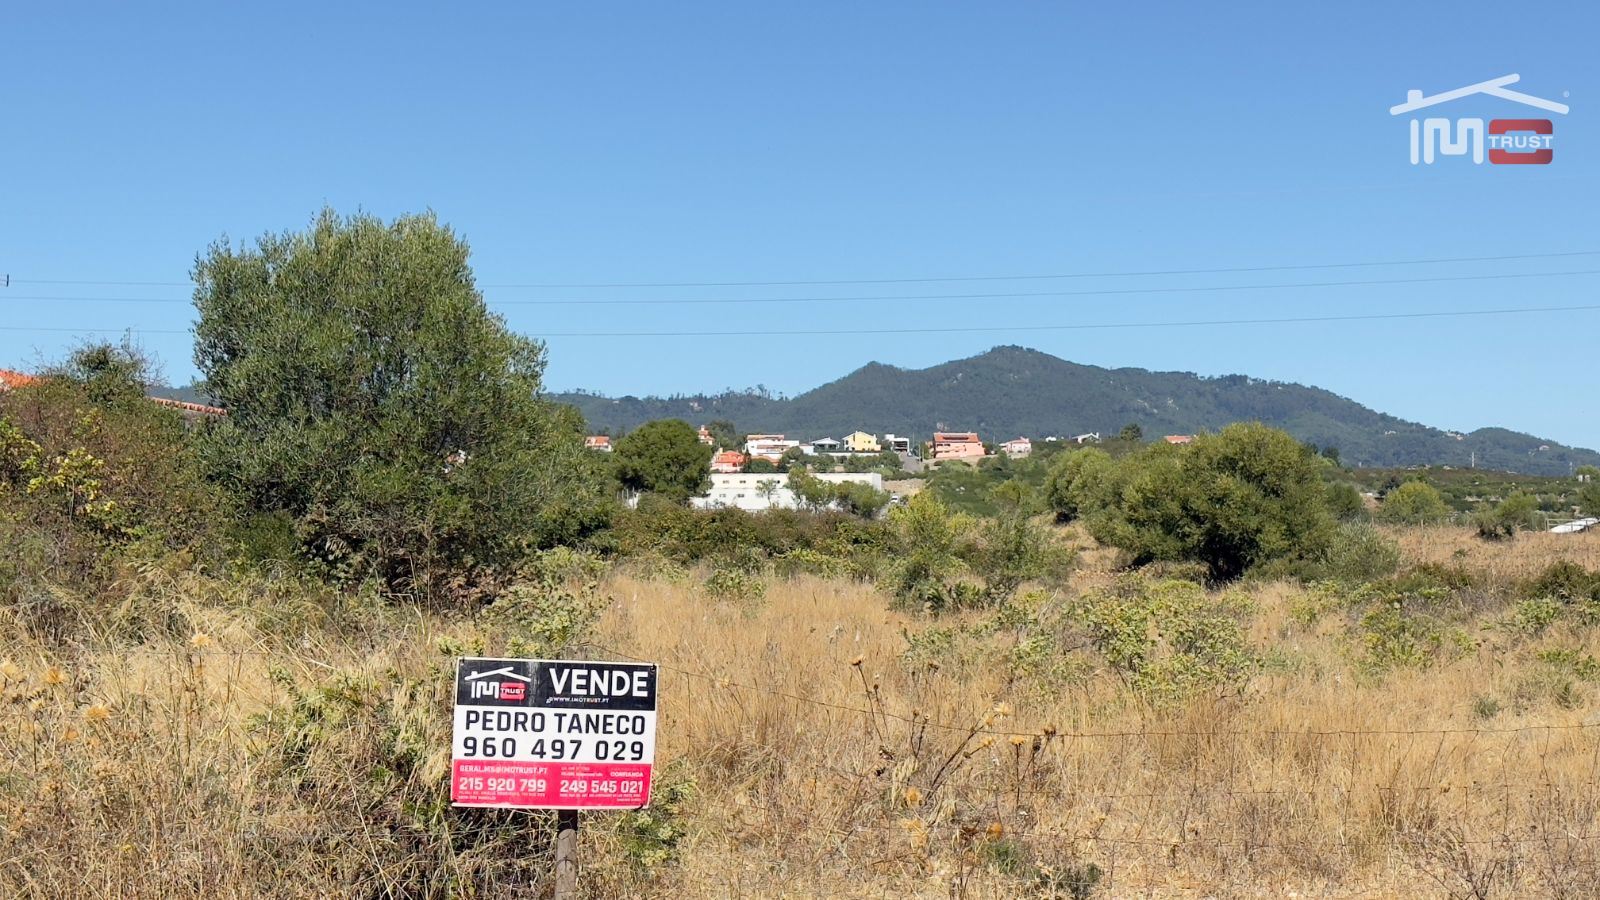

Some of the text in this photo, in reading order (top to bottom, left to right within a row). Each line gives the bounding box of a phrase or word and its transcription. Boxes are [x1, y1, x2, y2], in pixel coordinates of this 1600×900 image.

[549, 668, 649, 697] VENDE
[465, 710, 645, 735] PEDRO TANECO
[463, 736, 644, 761] 960 497 029
[459, 777, 546, 792] 215 920 799
[560, 779, 644, 794] 249 545 021
